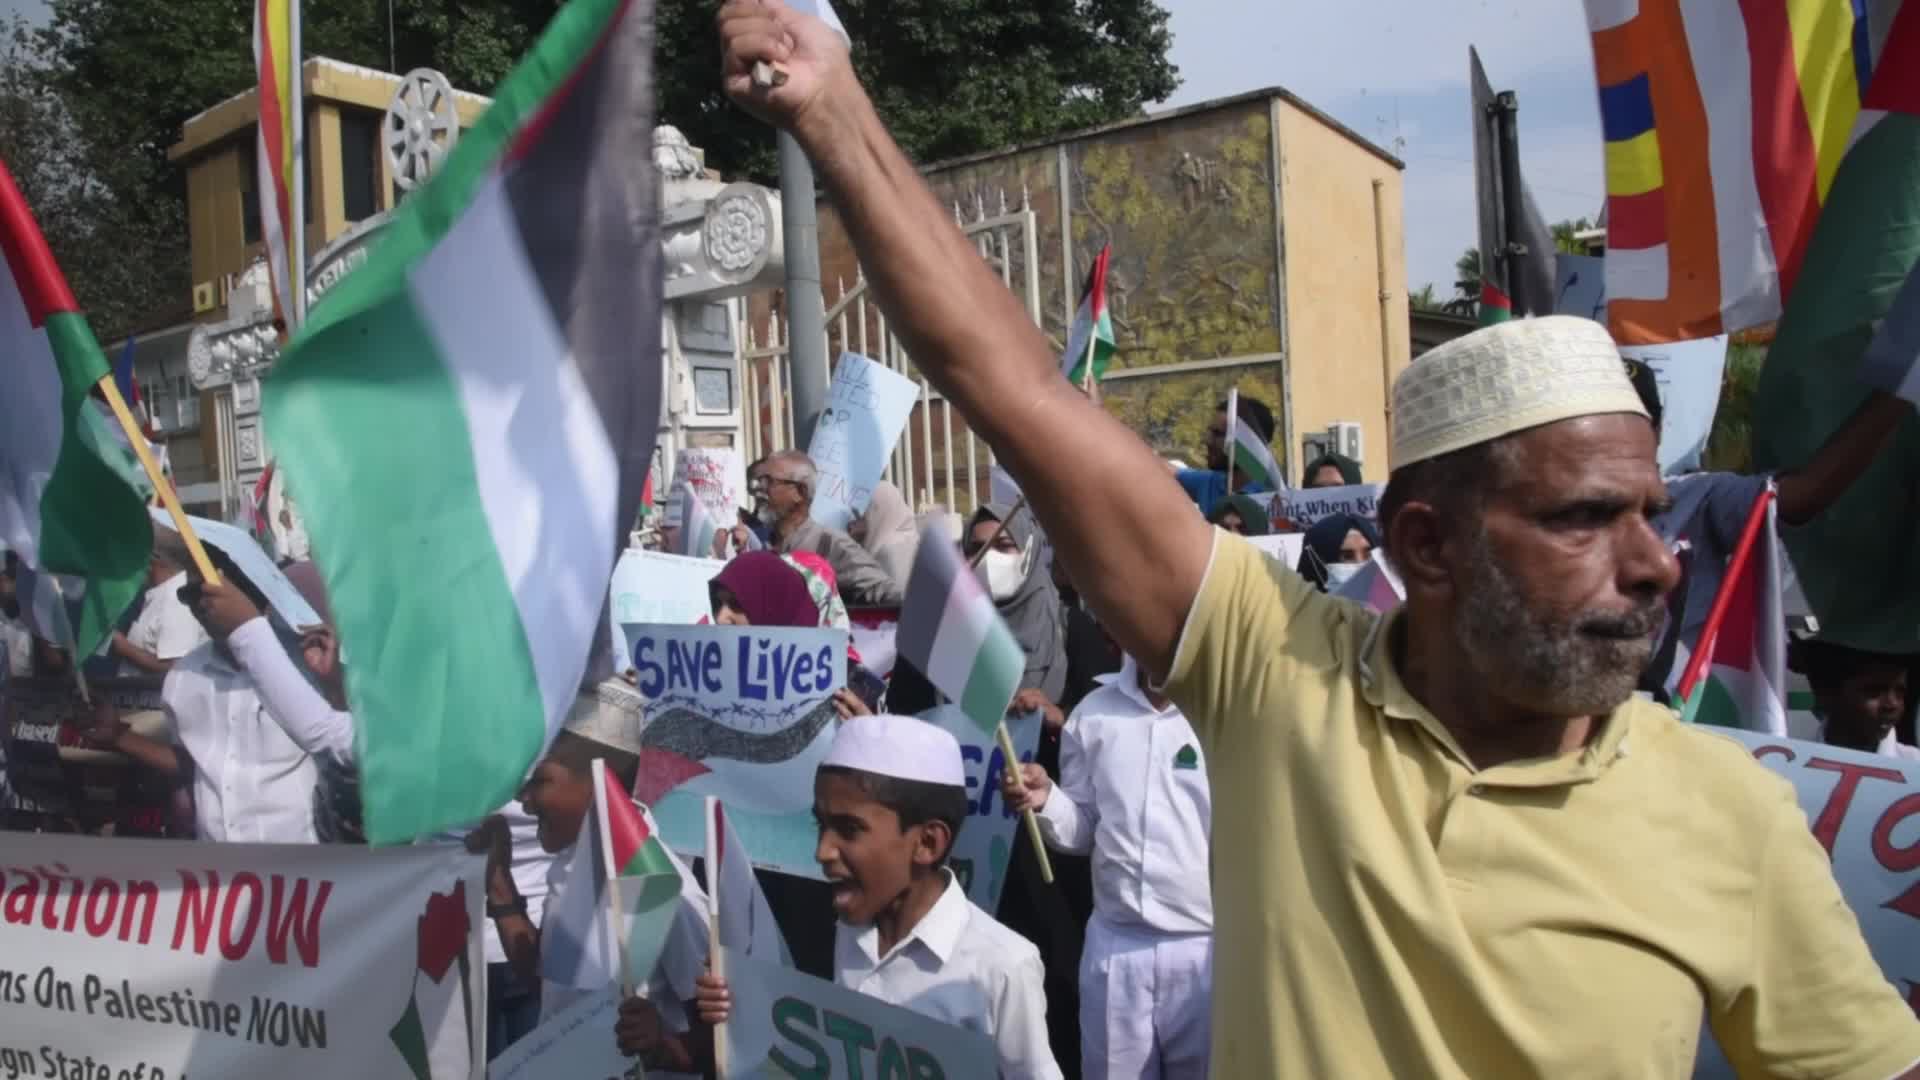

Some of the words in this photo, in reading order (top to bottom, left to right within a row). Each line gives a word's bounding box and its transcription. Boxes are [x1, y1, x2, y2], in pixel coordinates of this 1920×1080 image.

[1304, 499, 1351, 517] When
[0, 862, 159, 945] ation
[170, 869, 333, 968] NOW
[34, 966, 75, 1012] On
[84, 974, 241, 1036] Palestine
[247, 995, 327, 1049] NOW
[40, 1046, 111, 1080] State
